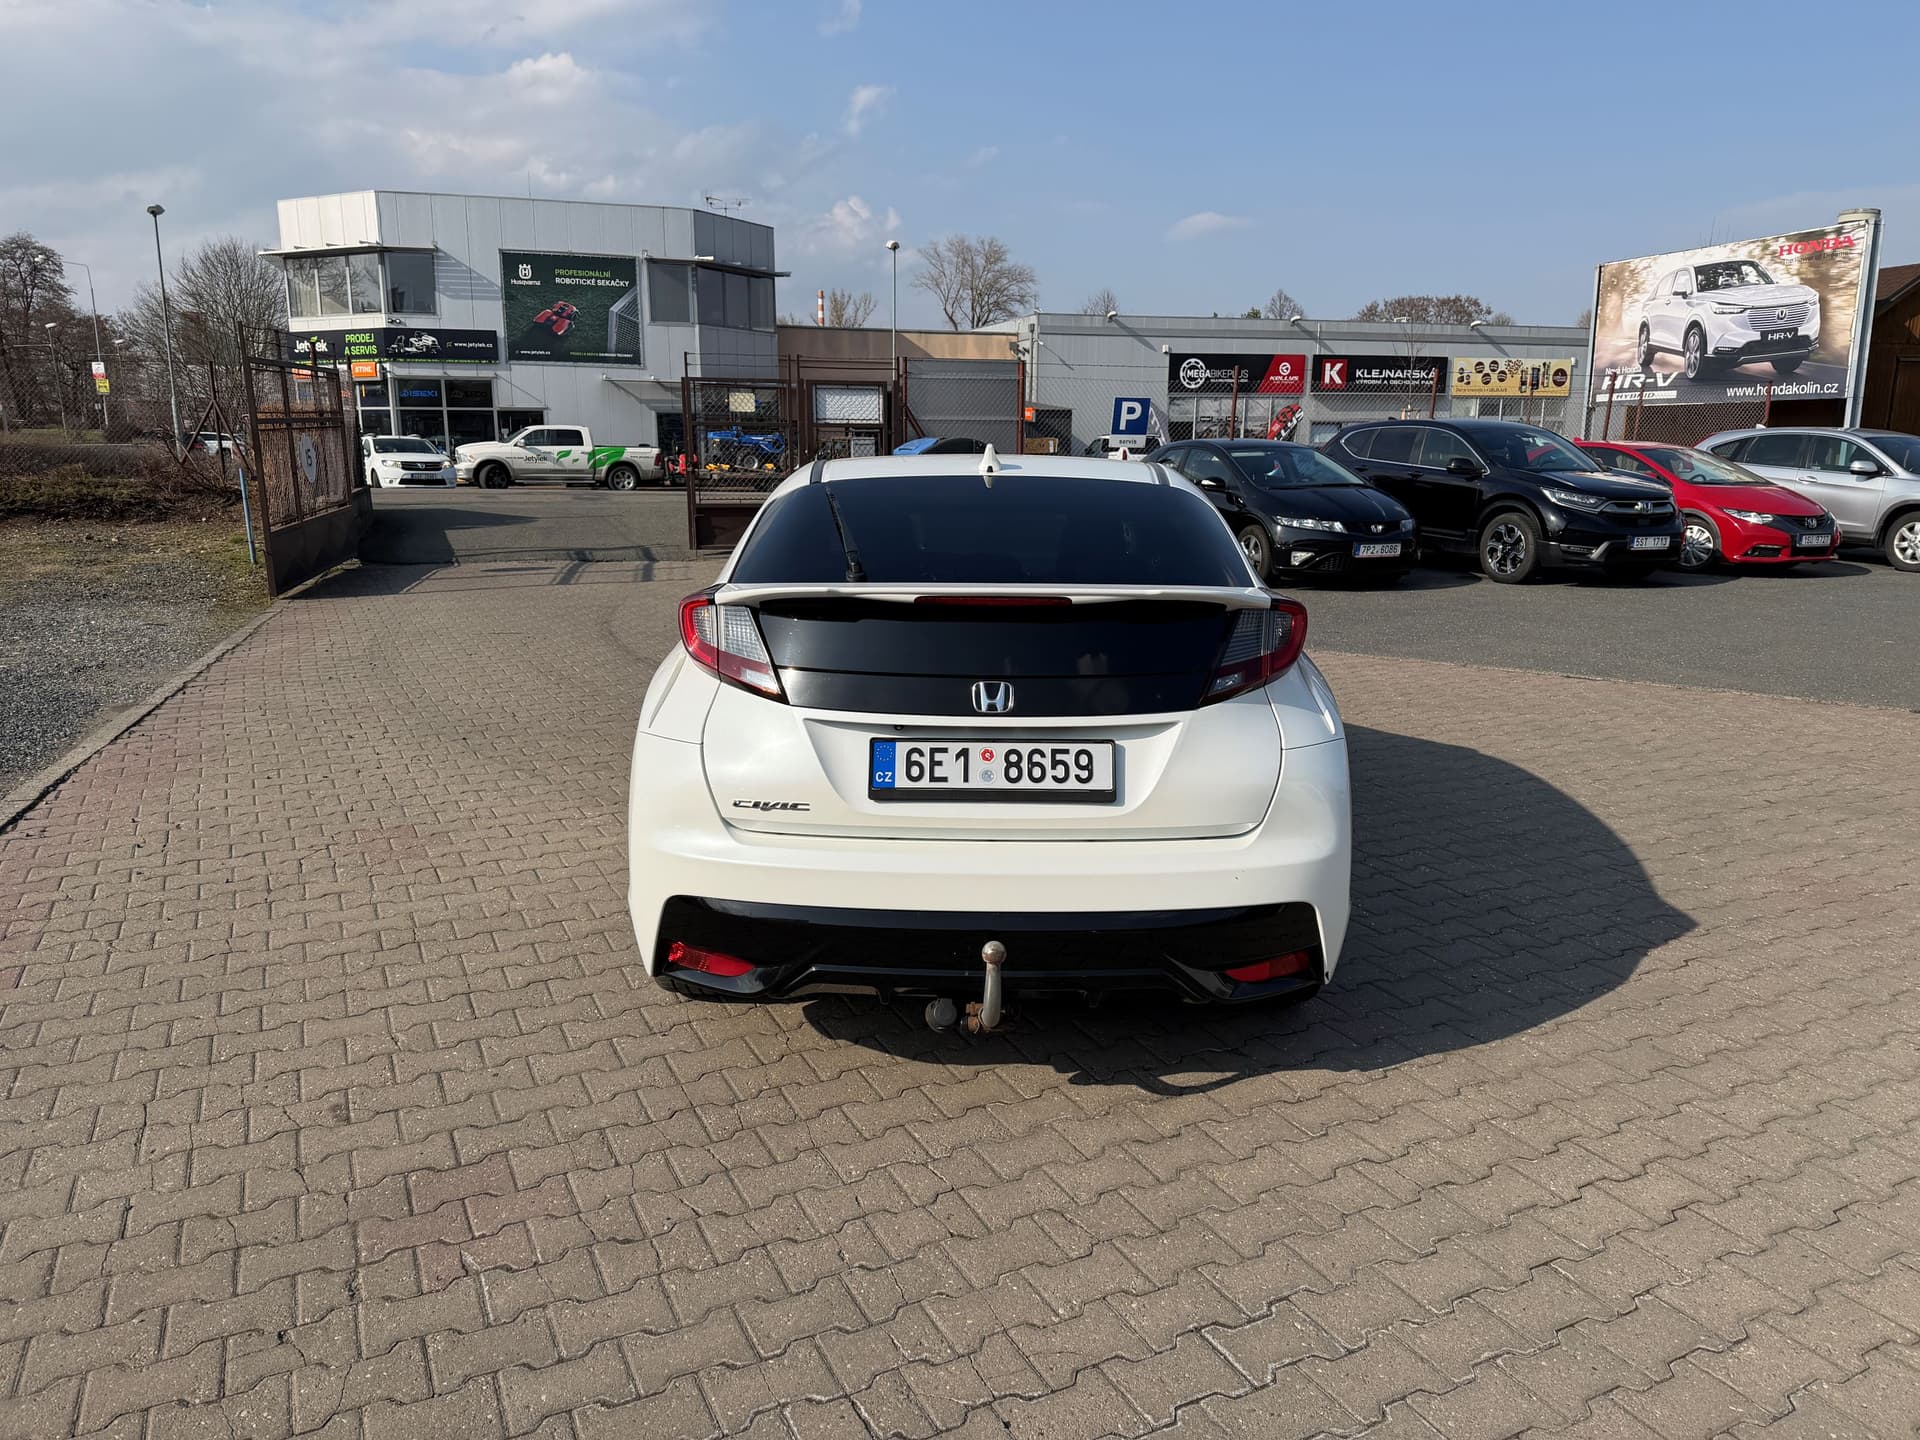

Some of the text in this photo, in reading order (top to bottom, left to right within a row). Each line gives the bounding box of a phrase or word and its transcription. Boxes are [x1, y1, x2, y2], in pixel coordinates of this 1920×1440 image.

[1777, 235, 1855, 257] HONDA
[555, 268, 611, 278] PROFESIONÁLNÍ
[555, 277, 630, 287] ROBOTICKÉ SEKAČKY
[345, 333, 374, 343] PRODEJ
[1768, 332, 1794, 340] HR-V
[345, 345, 377, 355] A SERVIS
[1324, 363, 1343, 384] K
[1355, 367, 1436, 379] KLEJNARSKÁ
[1601, 371, 1679, 390] HR-V
[1119, 401, 1142, 430] P
[1361, 545, 1376, 554] 7P2
[876, 747, 1094, 784] CZ 6E1 8659
[733, 800, 810, 811] CIVIC
